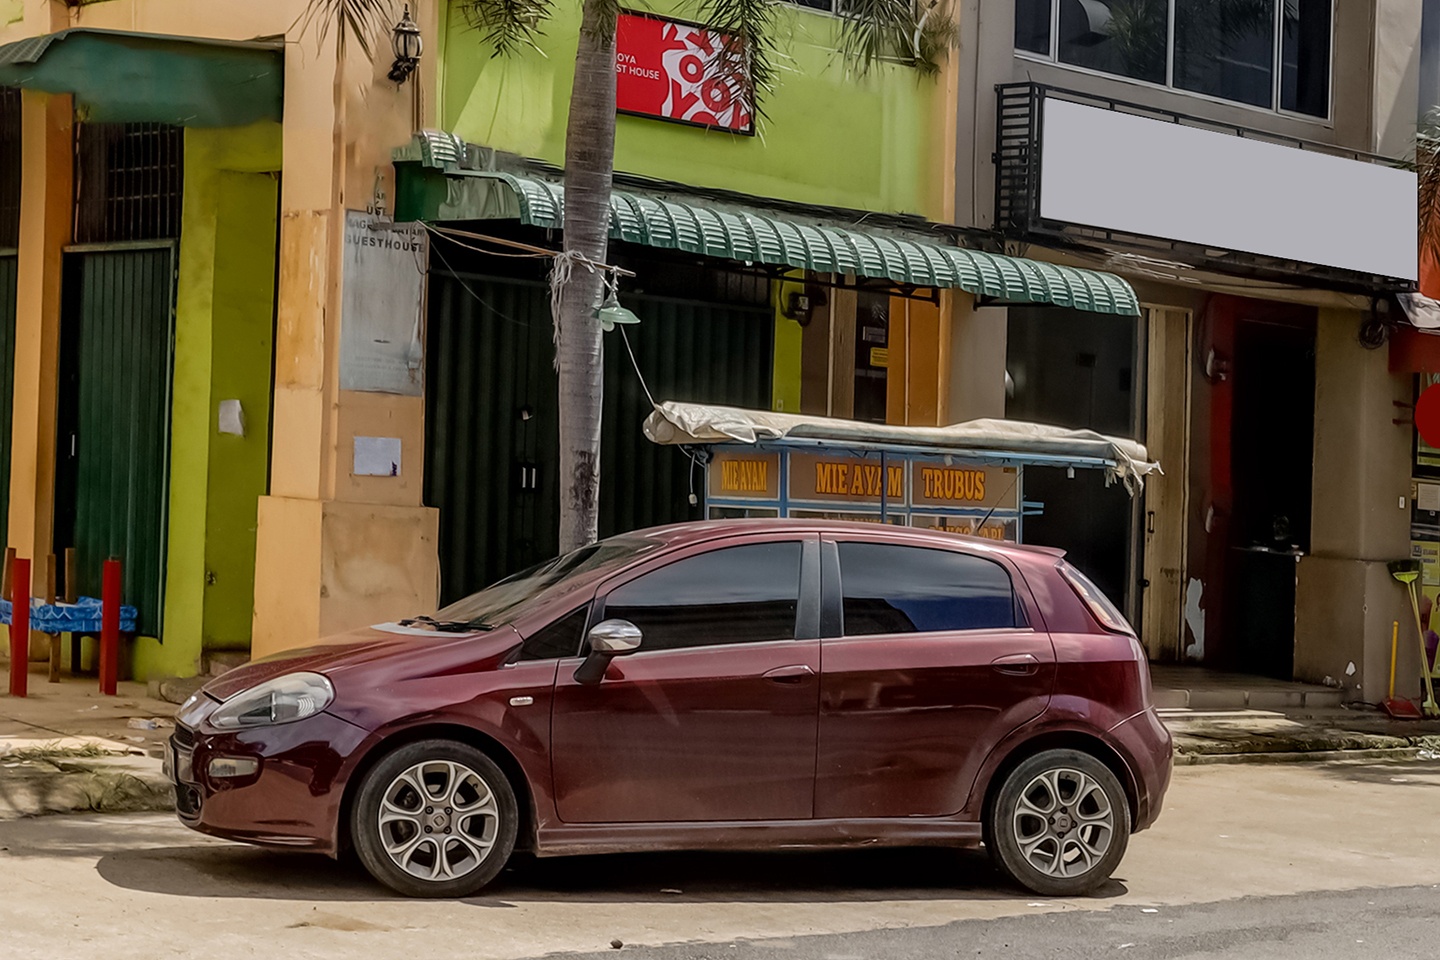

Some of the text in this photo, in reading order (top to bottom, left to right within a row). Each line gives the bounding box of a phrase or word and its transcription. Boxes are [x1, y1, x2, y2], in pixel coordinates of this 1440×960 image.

[629, 66, 660, 81] HOUSE
[345, 234, 425, 253] GUESTHOUSE
[722, 460, 768, 491] MIE AYAM
[815, 463, 848, 494] MIE
[922, 468, 985, 501] TRUBUS
